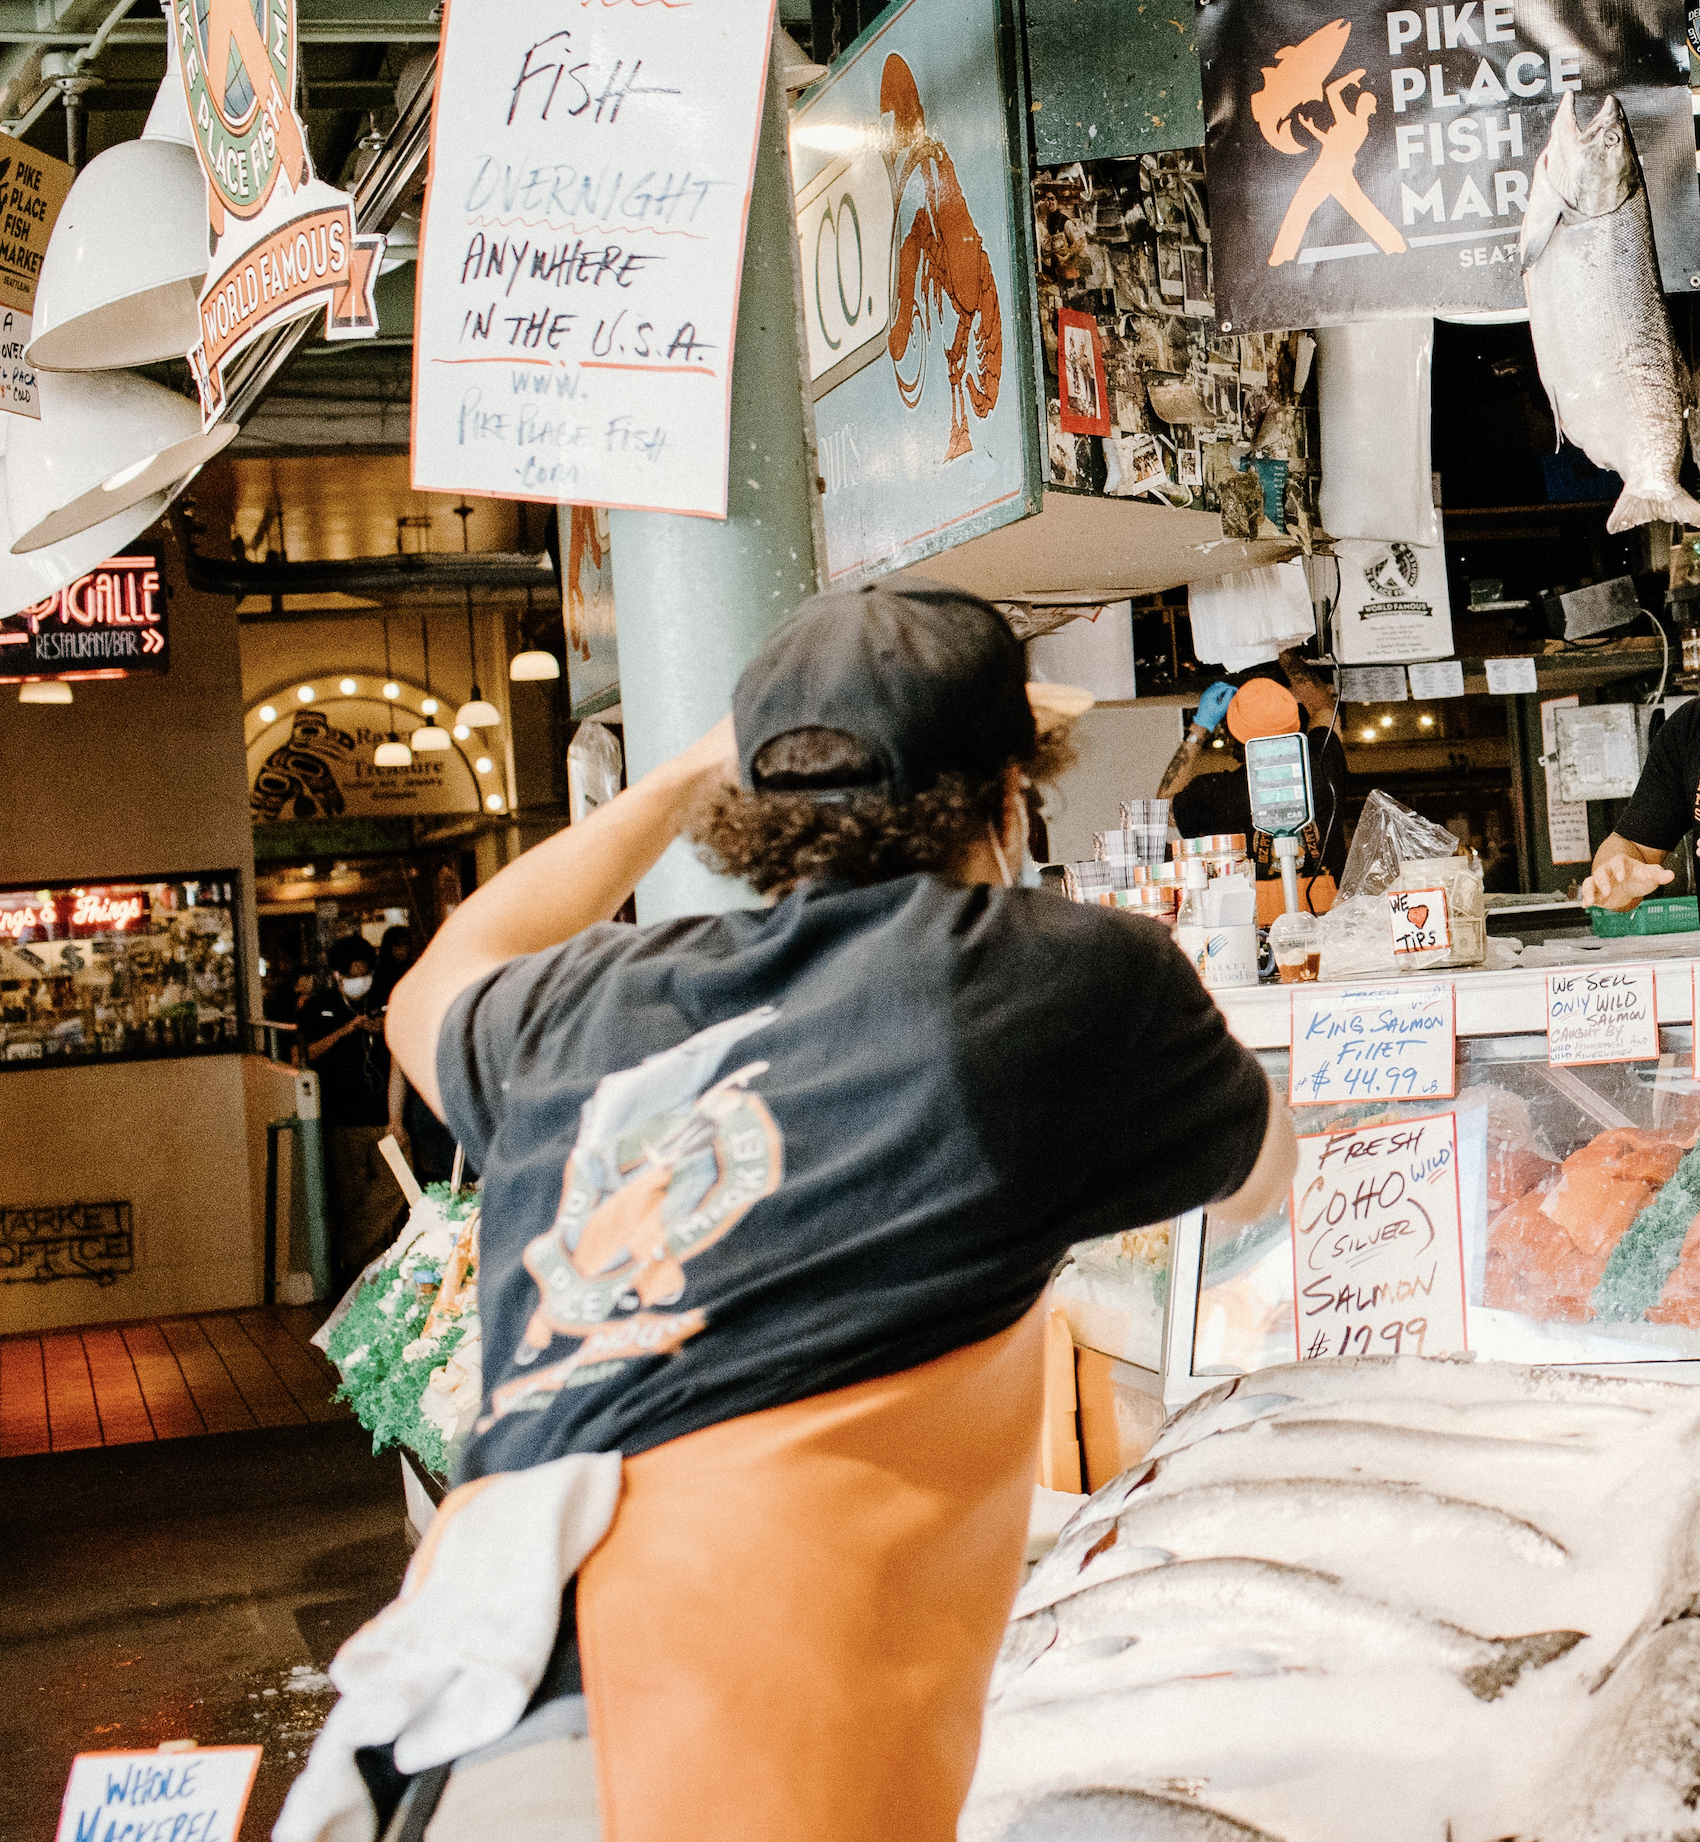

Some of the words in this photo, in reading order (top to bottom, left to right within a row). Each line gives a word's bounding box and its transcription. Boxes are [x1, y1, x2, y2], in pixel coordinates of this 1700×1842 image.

[1386, 0, 1516, 55] PIKE
[1688, 28, 1699, 45] CITY
[1391, 51, 1583, 113] PLACE
[197, 91, 249, 197] PLACE
[250, 77, 283, 189] FISH
[1395, 113, 1524, 170] FISH
[15, 161, 42, 191] PIKE
[464, 155, 737, 224] OVERNIGHT
[9, 188, 47, 222] PLACE
[4, 214, 31, 242] FISH
[461, 231, 667, 298] ANYWHERE
[204, 264, 259, 352] WORLD
[260, 220, 345, 303] FAMOUS
[460, 302, 496, 344] IN
[504, 306, 579, 350] THE
[592, 309, 719, 362] U.S.A.
[73, 896, 141, 930] Things
[1390, 894, 1409, 914] WE
[1553, 976, 1583, 994] WE
[1586, 972, 1637, 991] SELL
[1586, 1005, 1646, 1027] SALMON
[1596, 991, 1637, 1012] WILD
[1306, 1012, 1364, 1040] KING
[1370, 1009, 1444, 1033] SALMON
[1551, 1027, 1600, 1043] CAUGHT
[1606, 1025, 1624, 1041] BY
[1551, 1044, 1571, 1053] WILD
[1574, 1040, 1624, 1051] FISHERMEN
[1631, 1034, 1648, 1046] AND
[1551, 1052, 1572, 1060] WILD
[1422, 1080, 1438, 1093] LB
[1319, 1127, 1426, 1170] FRESH
[1298, 1172, 1406, 1234] COHO
[1303, 1261, 1437, 1316] SALMON
[106, 1759, 203, 1806] WHOLE
